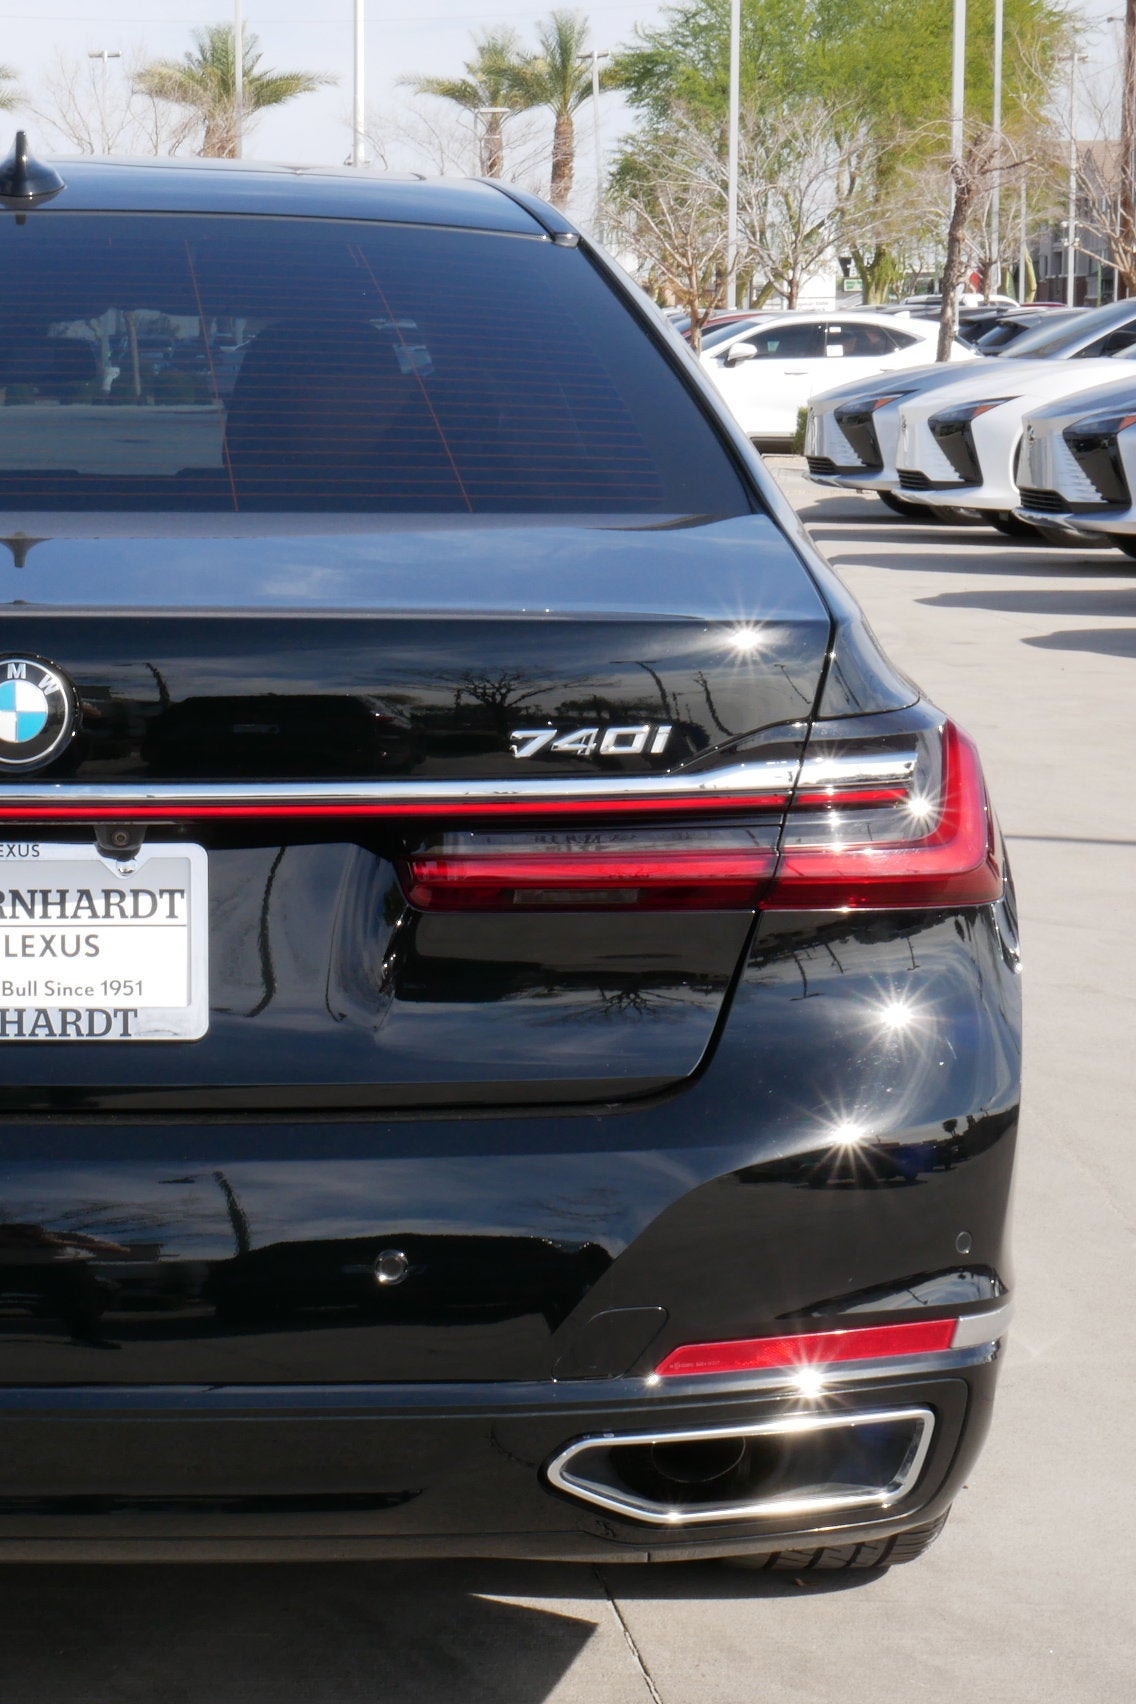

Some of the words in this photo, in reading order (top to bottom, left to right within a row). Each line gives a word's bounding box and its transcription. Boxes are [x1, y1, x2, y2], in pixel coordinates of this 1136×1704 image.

[509, 725, 672, 759] 740i
[4, 934, 101, 958] LEXUS
[1, 979, 38, 997] Bull
[44, 979, 95, 997] Since
[101, 979, 144, 997] 1951
